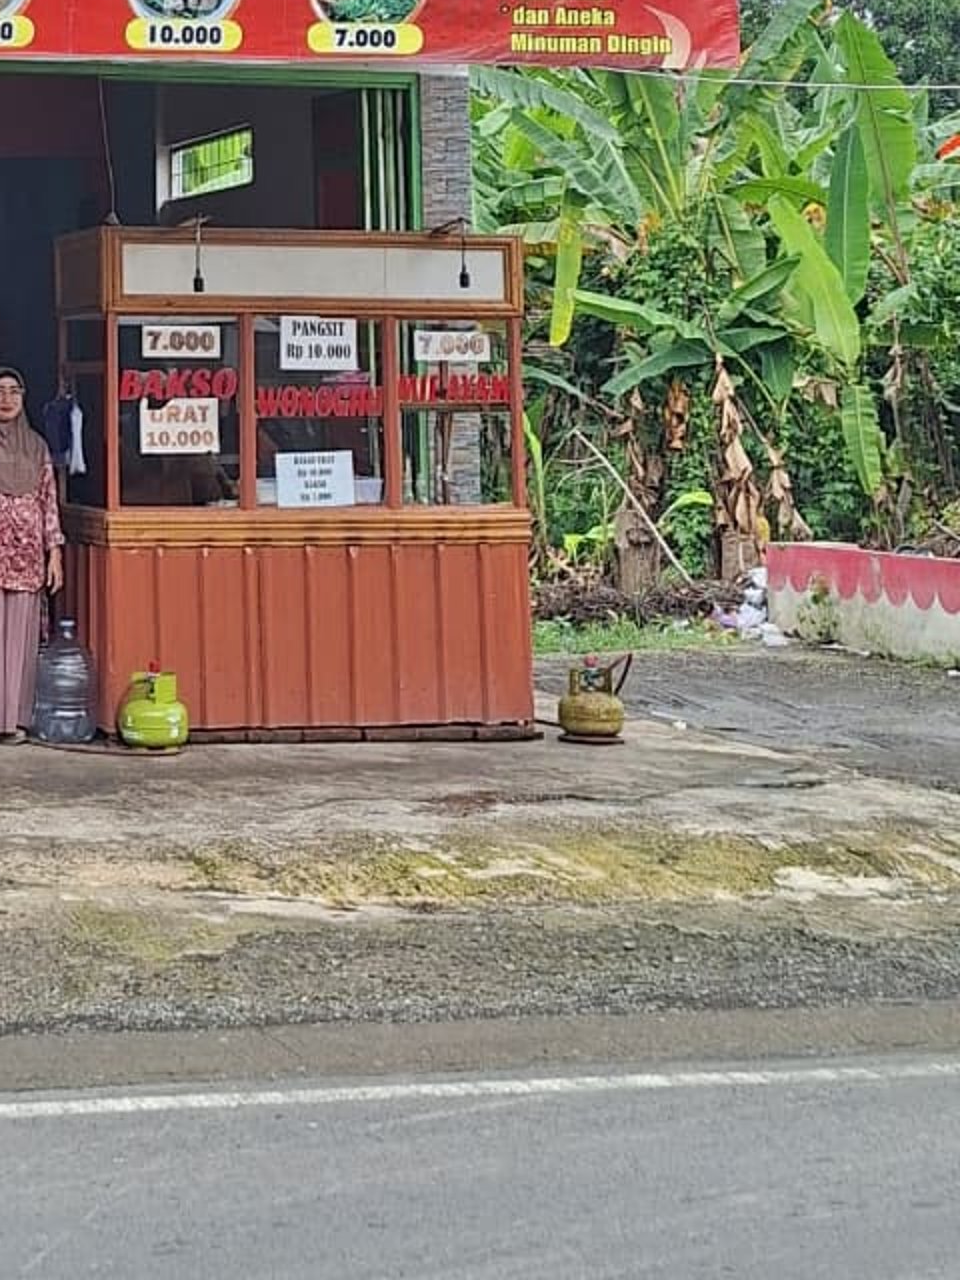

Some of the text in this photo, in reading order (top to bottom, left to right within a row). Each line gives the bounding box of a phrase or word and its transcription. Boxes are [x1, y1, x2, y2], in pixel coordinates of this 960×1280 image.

[513, 6, 615, 25] dan Aneka
[148, 25, 221, 45] 10.000
[335, 29, 395, 47] 7.000
[511, 32, 672, 55] Minuman Dingin
[291, 321, 344, 337] PANGSIT
[146, 331, 215, 352] 7.000
[307, 343, 352, 360] 10.000
[119, 367, 238, 402] BAKSO
[145, 431, 215, 448] 10.000
